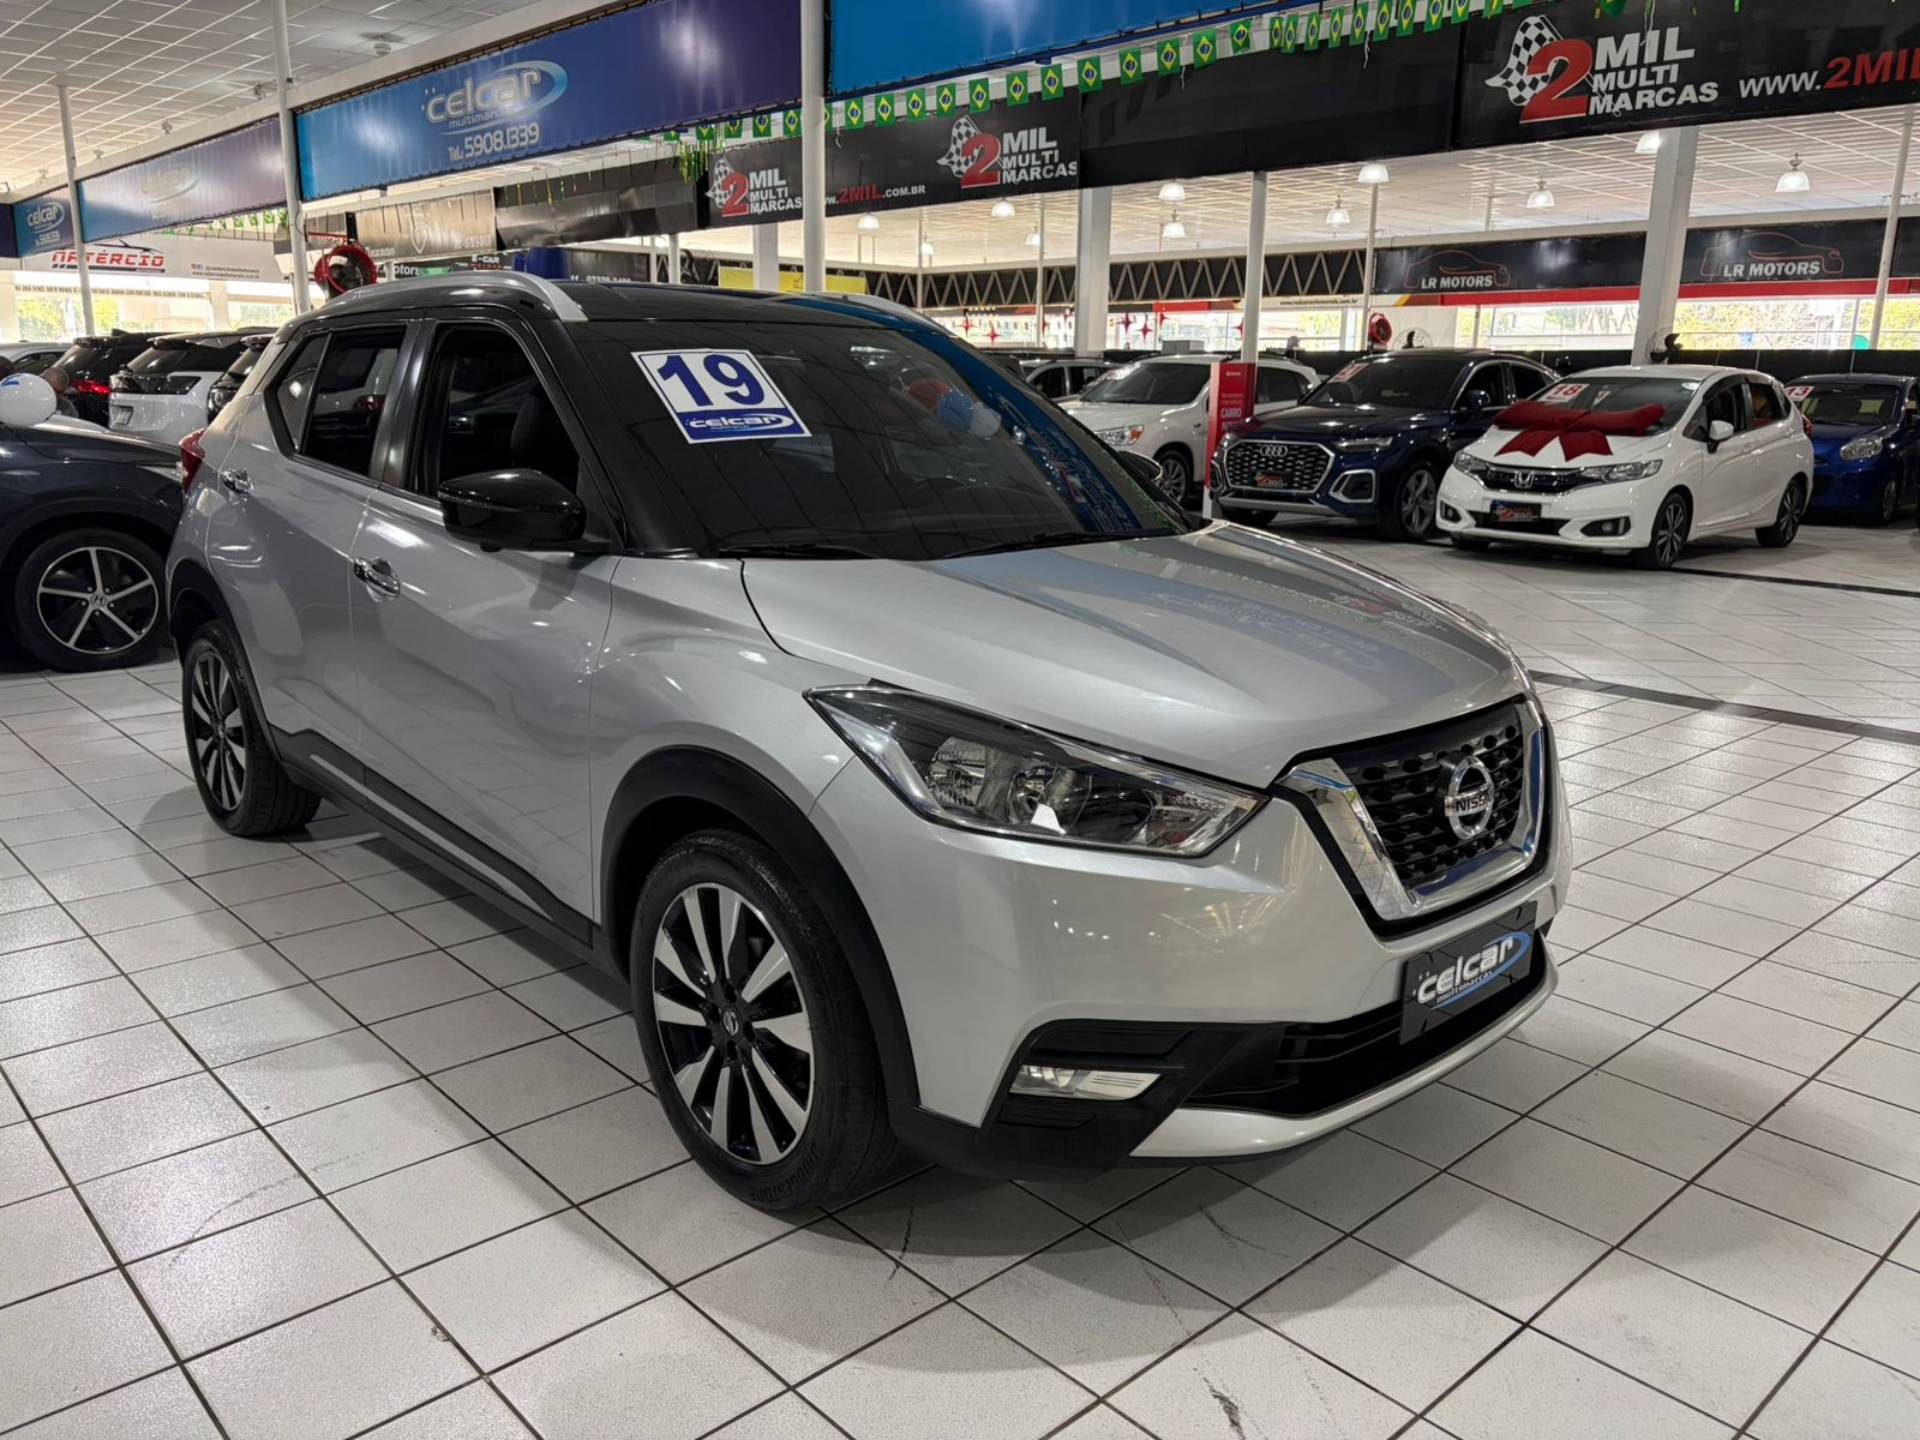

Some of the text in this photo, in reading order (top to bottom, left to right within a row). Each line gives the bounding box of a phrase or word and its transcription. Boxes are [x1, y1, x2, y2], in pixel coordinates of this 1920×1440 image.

[1519, 26, 1696, 123] 2 MIL
[1592, 63, 1680, 93] MULTI
[427, 70, 541, 123] celcar
[1589, 82, 1720, 115] MARCAS
[464, 122, 540, 158] 5908.1339
[961, 126, 1058, 188] 2 MIL
[1002, 149, 1060, 170] MULTI
[1002, 161, 1078, 184] MARCAS
[722, 168, 787, 217] 2 MIL
[749, 187, 789, 201] MULTI
[749, 196, 804, 214] MARCAS
[27, 206, 58, 227] celcar
[1421, 275, 1493, 289] LR MOTORS
[1723, 261, 1820, 277] LR MOTORS
[657, 354, 765, 407] 19
[690, 416, 777, 429] celcar
[1418, 936, 1514, 1004] celcar
